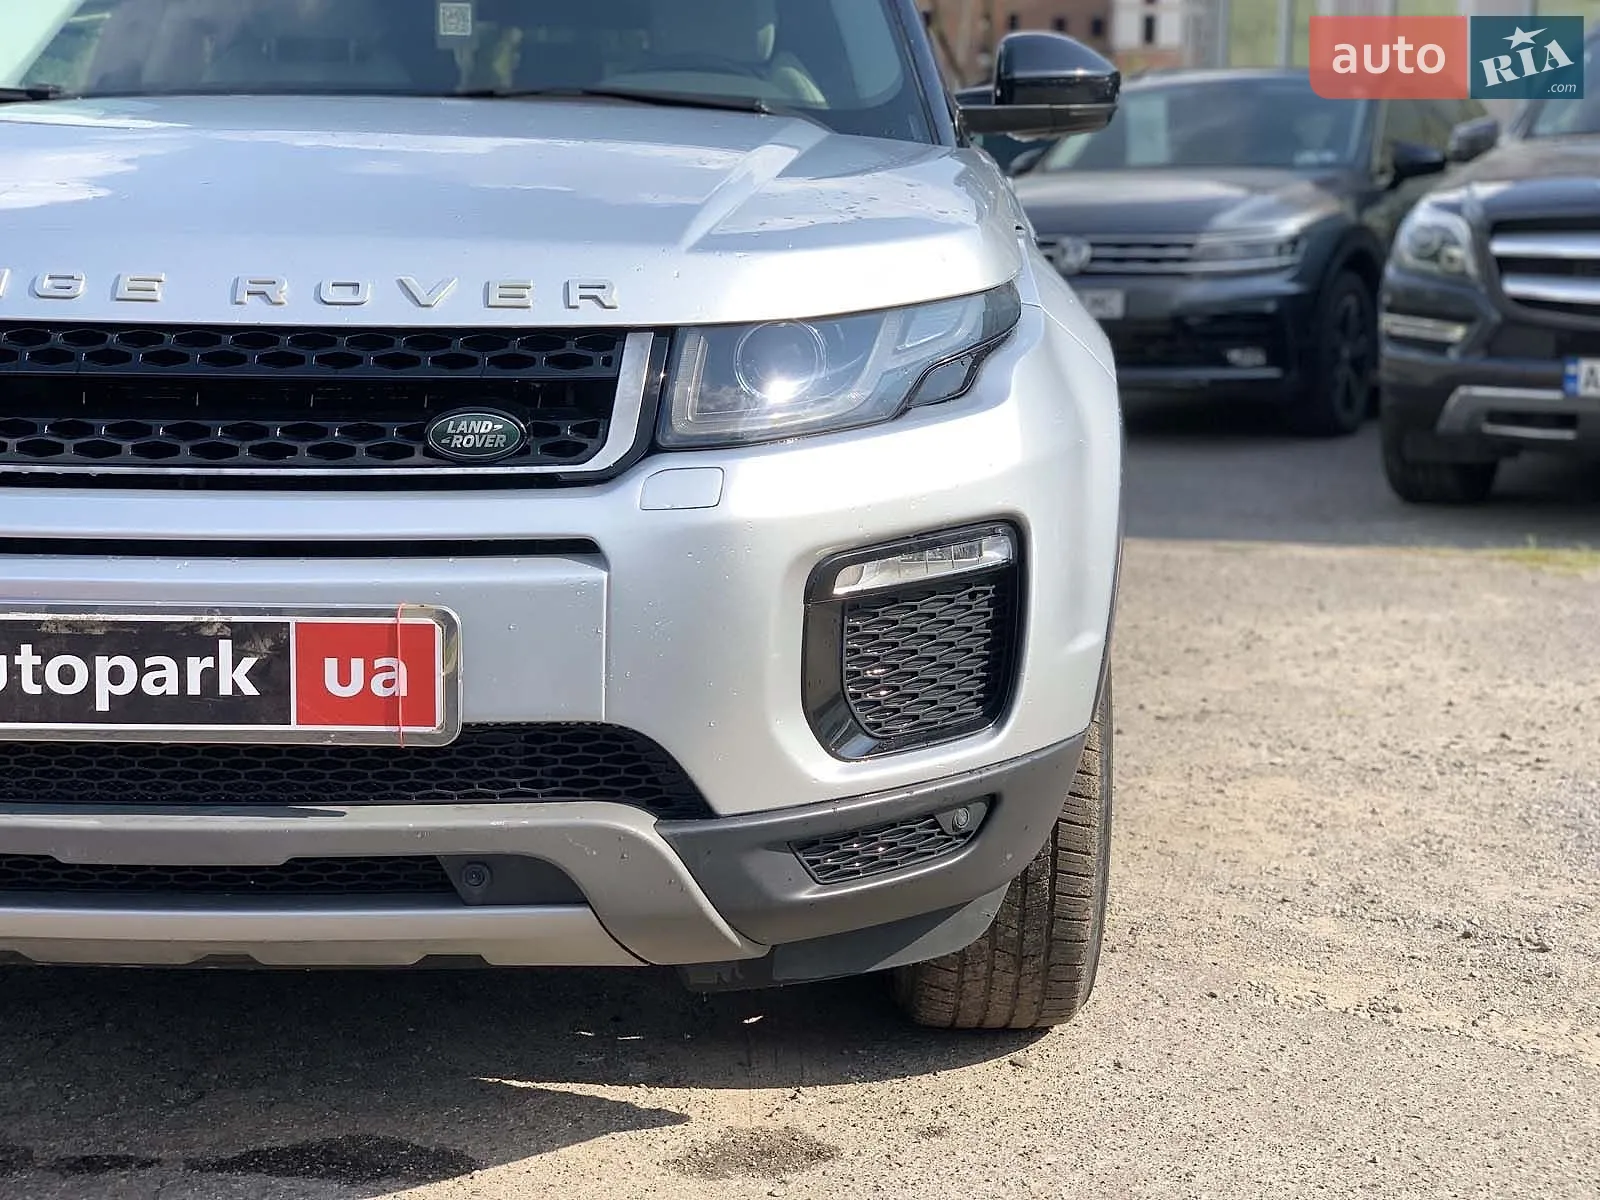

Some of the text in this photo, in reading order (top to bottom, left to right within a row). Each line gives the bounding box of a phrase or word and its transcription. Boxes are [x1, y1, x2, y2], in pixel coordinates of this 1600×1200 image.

[233, 274, 619, 309] ROVER
[446, 420, 492, 434] LAND
[450, 434, 507, 448] ROVER
[0, 639, 408, 712] topark ua
